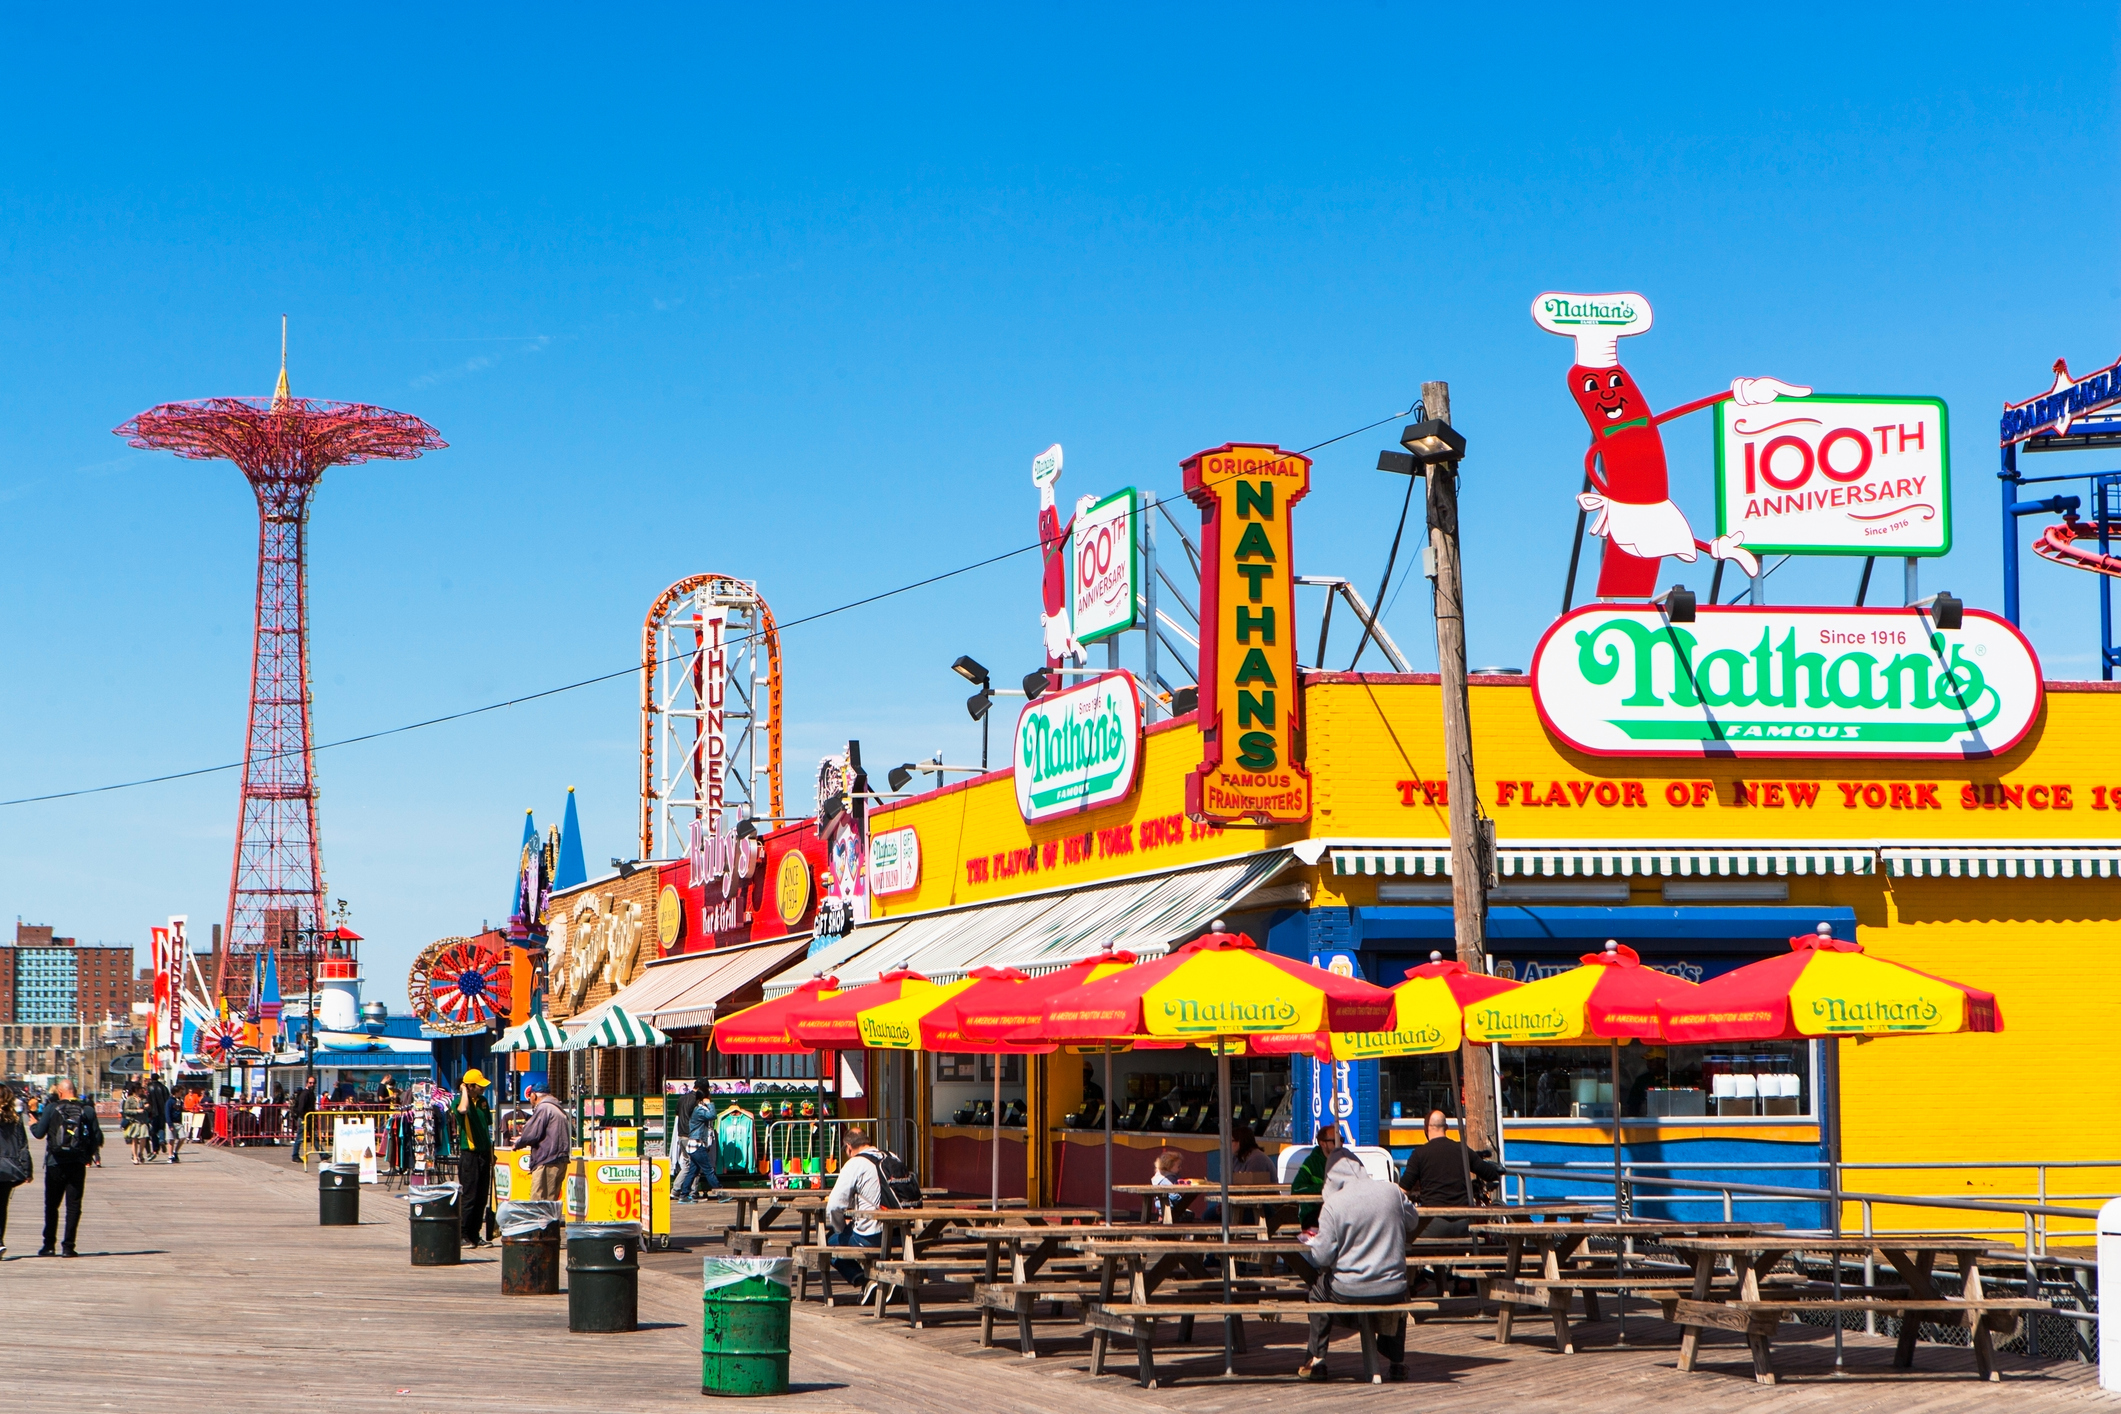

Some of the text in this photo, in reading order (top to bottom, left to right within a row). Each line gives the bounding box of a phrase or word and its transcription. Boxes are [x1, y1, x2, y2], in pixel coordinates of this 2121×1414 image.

[1545, 299, 1635, 319] Nathan's
[1208, 458, 1299, 477] ORIGINAL
[1745, 421, 1924, 495] 100TH
[1744, 476, 1927, 520] ANNIVERSARY
[1864, 519, 1910, 537] Since 1916
[1077, 510, 1126, 596] 100TH
[1077, 560, 1127, 617] ANNIVERSARY
[1234, 480, 1276, 769] NATHANS
[1819, 629, 1906, 645] Since 1916
[1575, 618, 2001, 712] Nathan's
[1022, 693, 1123, 784] Nathan's
[1726, 724, 1862, 739] FAMOUS
[1056, 782, 1090, 801] FAMOUS
[1221, 774, 1291, 788] FAMOUS
[1208, 785, 1303, 811] FRANKFURTERS
[1396, 780, 2121, 811] TH FLAVOR OF NEW YORK SINCE 19
[688, 804, 752, 899] Ruby's
[966, 856, 989, 886] THE
[992, 846, 1038, 880] FLAVOR
[1042, 840, 1058, 871] OF
[1063, 831, 1093, 868] NEW
[1097, 824, 1134, 860] YORK
[1140, 812, 1185, 851] SINCE
[784, 865, 799, 889] SINCE
[813, 908, 845, 938] GIFT SHOP
[1164, 997, 1295, 1023] Nathan's
[1477, 1007, 1565, 1031] Nathan's
[1615, 1014, 1649, 1023] AMERICAN
[1812, 996, 1937, 1022] Nathan's
[863, 1018, 909, 1040] Nathan's
[1270, 1033, 1299, 1043] AMERICAN
[1299, 1032, 1317, 1042] TRADI
